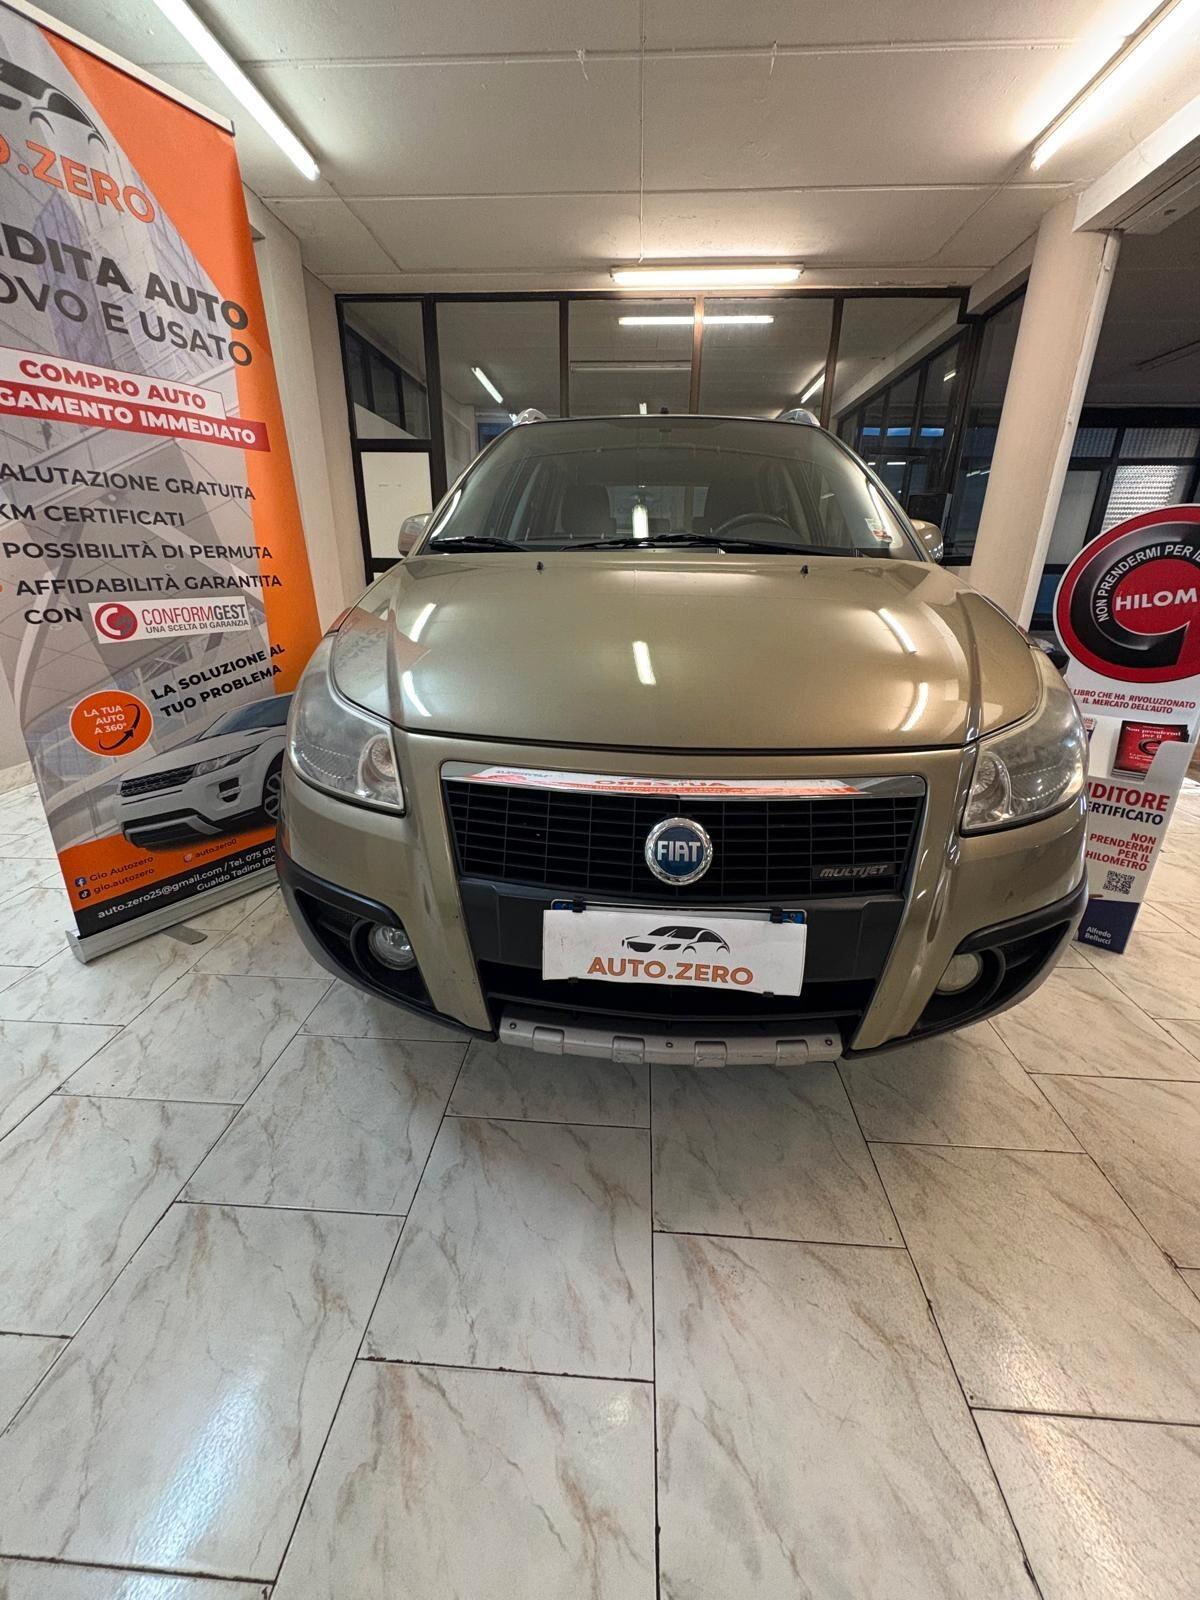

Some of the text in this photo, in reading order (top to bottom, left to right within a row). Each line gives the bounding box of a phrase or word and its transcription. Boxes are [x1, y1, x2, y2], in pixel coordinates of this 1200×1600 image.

[0, 223, 248, 330] DITA AUTO
[101, 301, 128, 334] E
[139, 310, 252, 366] USATO
[19, 360, 206, 410] COMPRO AUTO
[139, 410, 256, 444] IMMEDIATO
[0, 463, 256, 500] ALUTAZIONE GRATUITA
[44, 504, 185, 526] CERTIFICATI
[2, 541, 272, 559] POSSIBILITÀ DI PERMUTA
[1164, 544, 1193, 557] PER
[1097, 545, 1160, 597] PRENDERMI
[16, 574, 282, 596] AFFIDABILITÀ GARANTITA
[24, 607, 82, 625] CON
[141, 603, 246, 626] CONFORMGEST
[1095, 598, 1110, 622] NON
[145, 617, 249, 634] UNA SCELTA DI GARANZIA
[150, 644, 285, 701] LA SOLUZIONE AL
[160, 664, 282, 718] TUO PROBLEMA
[1073, 688, 1196, 709] LIBRO CHE HA RIVOLUZIONATO
[83, 704, 123, 718] LA TUA
[1092, 698, 1129, 709] MERCATO
[1130, 703, 1173, 714] DELL'AUTO
[95, 713, 126, 726] AUTO
[94, 726, 105, 736] A
[1086, 781, 1171, 812] DITORE
[1089, 833, 1154, 854] PRENDERMI
[1130, 832, 1157, 845] NON
[657, 839, 701, 863] FIAT
[1085, 850, 1147, 872] HILOMETRO
[1117, 848, 1151, 864] PER IL
[109, 855, 155, 876] Autozero
[820, 865, 888, 878] MULTIJET
[98, 865, 223, 919] auto.zero25@gmail.com
[229, 856, 245, 868] Tel.
[245, 850, 261, 862] 075
[196, 873, 231, 892] Gualdo
[230, 862, 261, 878] Tadino
[1084, 932, 1111, 946] Bellucci
[1086, 926, 1112, 939] Alfredo
[587, 956, 753, 986] AUTO.ZERO
